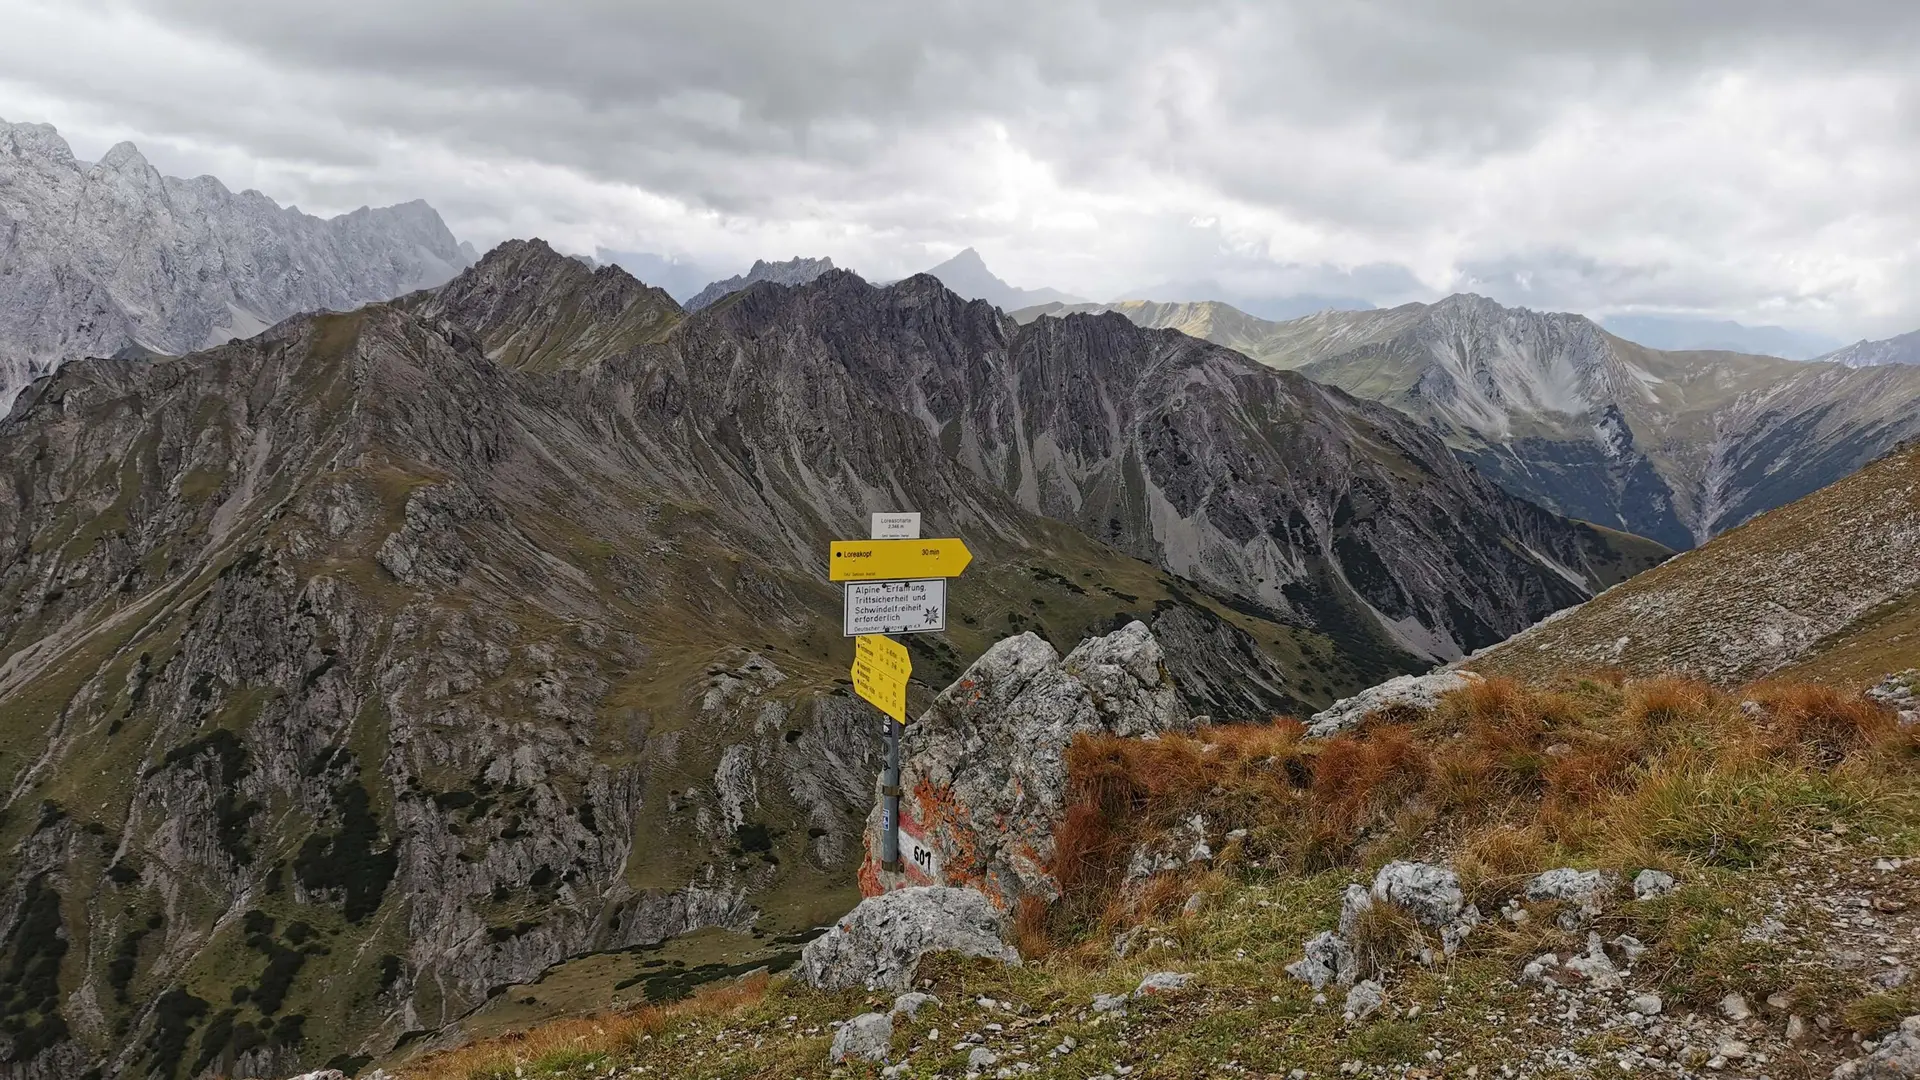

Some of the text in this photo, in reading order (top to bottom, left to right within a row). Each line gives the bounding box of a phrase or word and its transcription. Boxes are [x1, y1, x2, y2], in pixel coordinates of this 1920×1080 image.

[844, 550, 872, 559] Loreakopf
[855, 586, 881, 595] Alpine
[855, 595, 909, 604] Trittsicherheit
[854, 604, 922, 614] Schwindelfreiheit
[854, 614, 901, 623] erforderlich
[913, 845, 931, 871] 601
